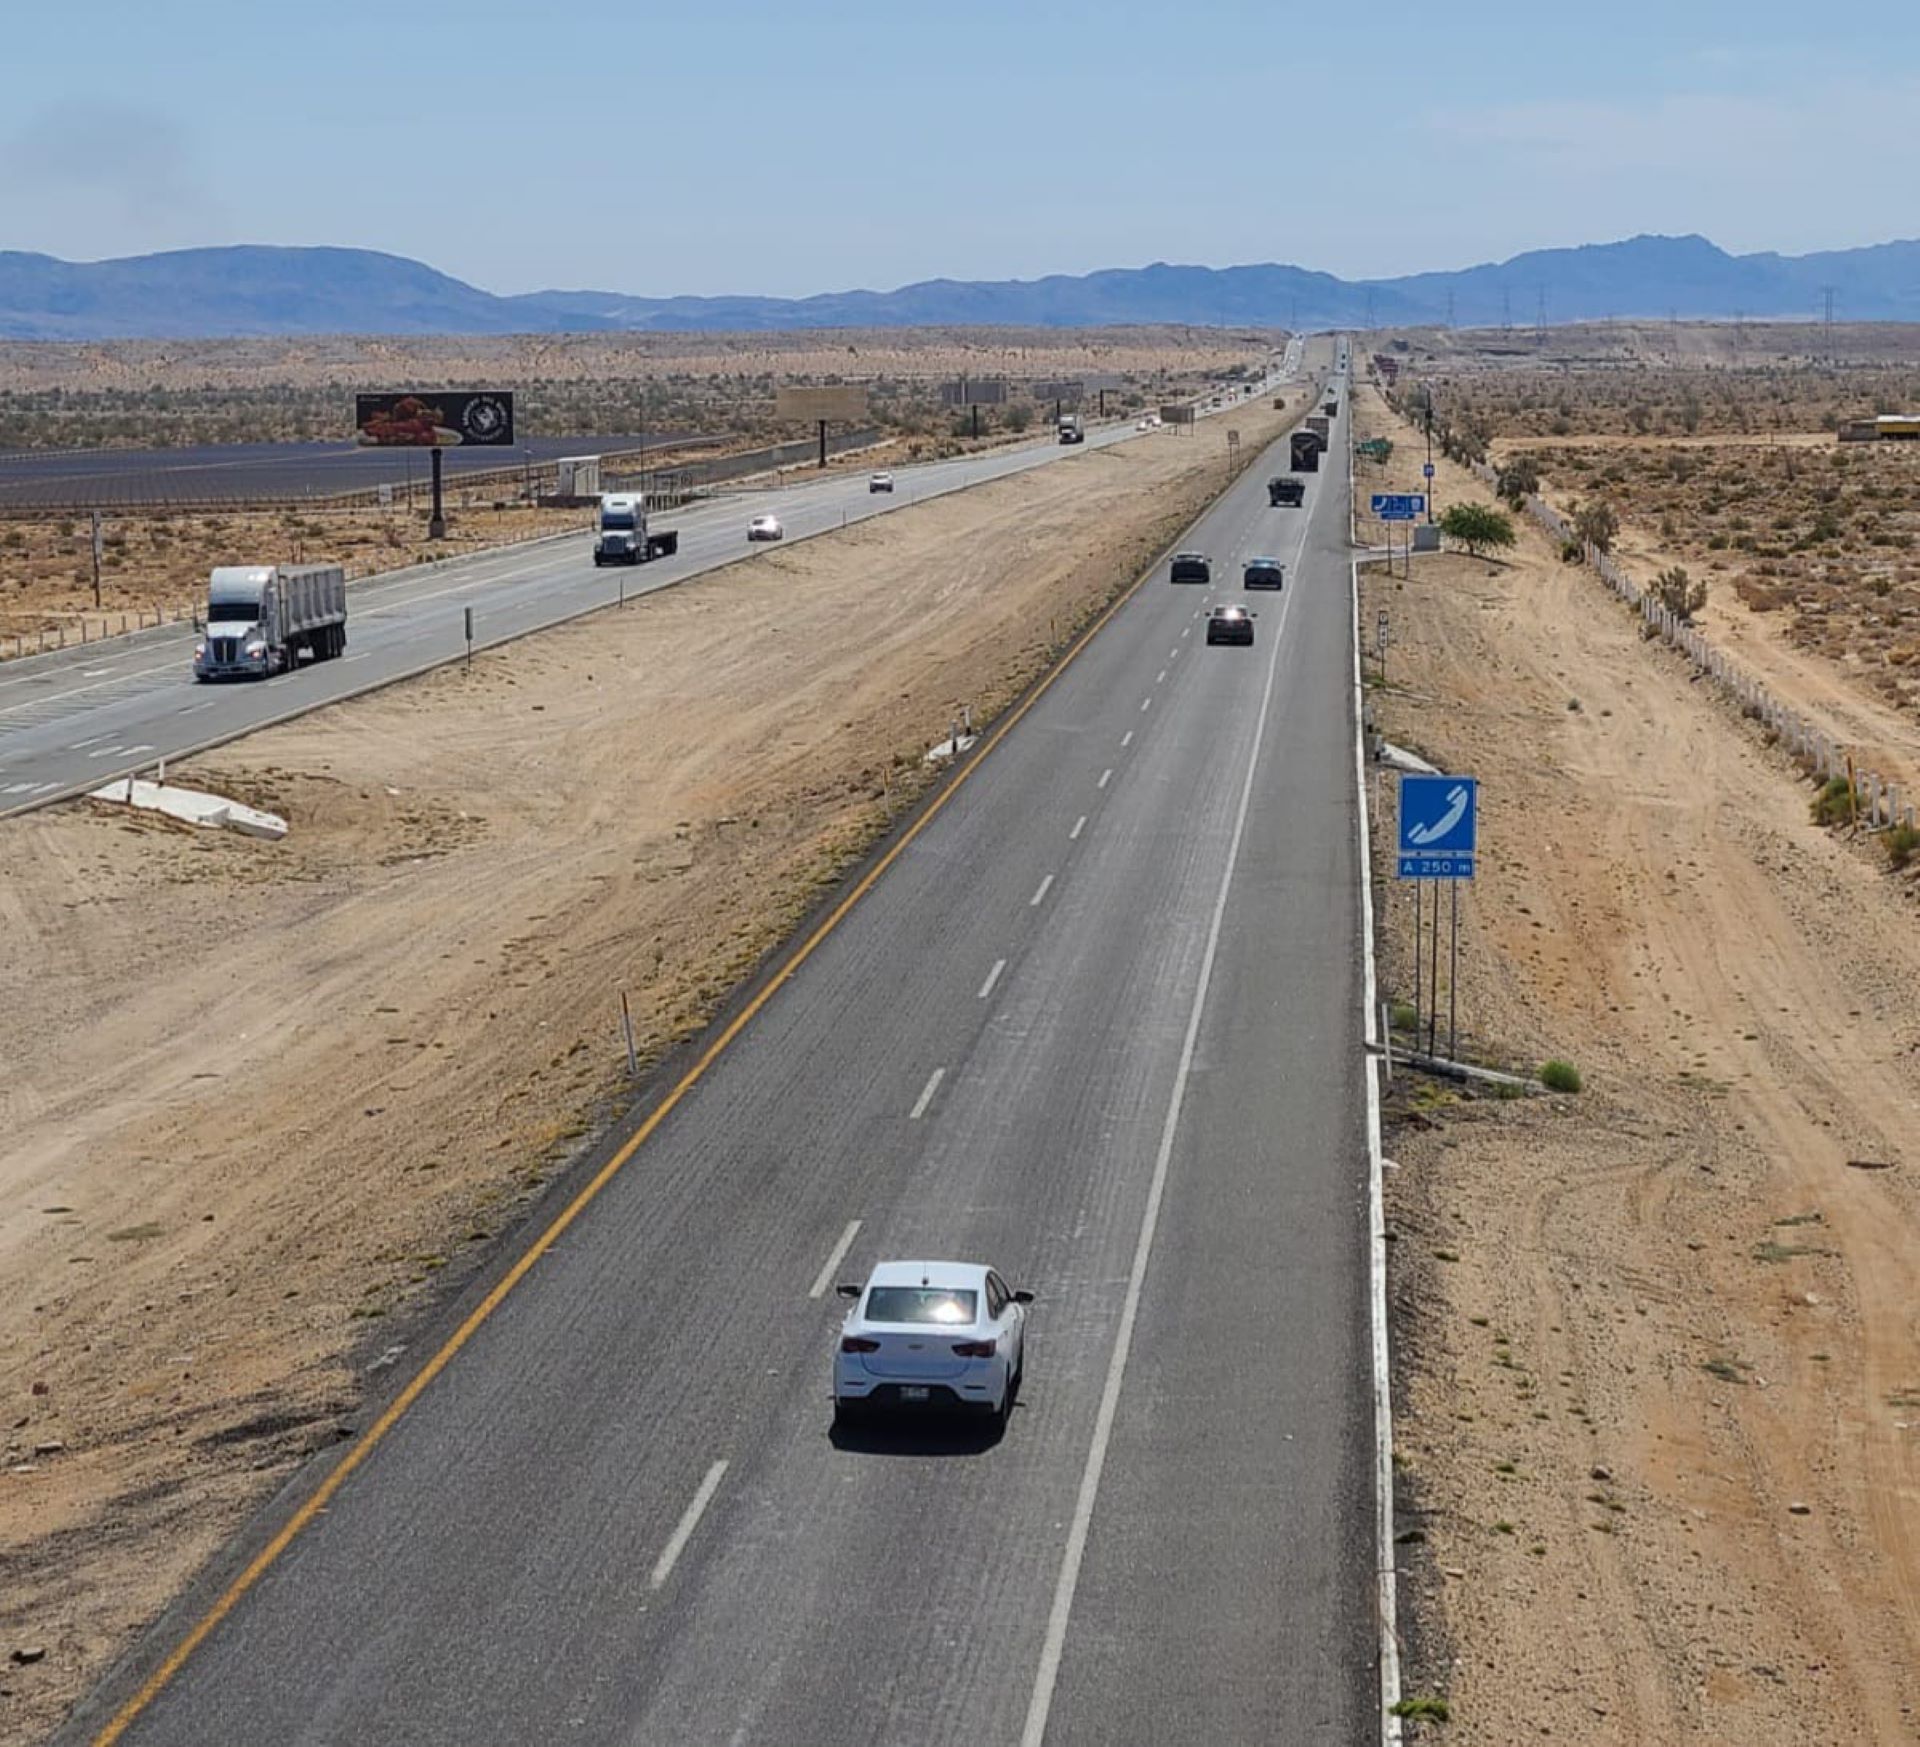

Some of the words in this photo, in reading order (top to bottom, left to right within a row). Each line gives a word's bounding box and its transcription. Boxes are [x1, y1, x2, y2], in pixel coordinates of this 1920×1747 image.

[1403, 861, 1413, 873] A
[1421, 861, 1451, 873] 250
[1458, 864, 1470, 873] m
